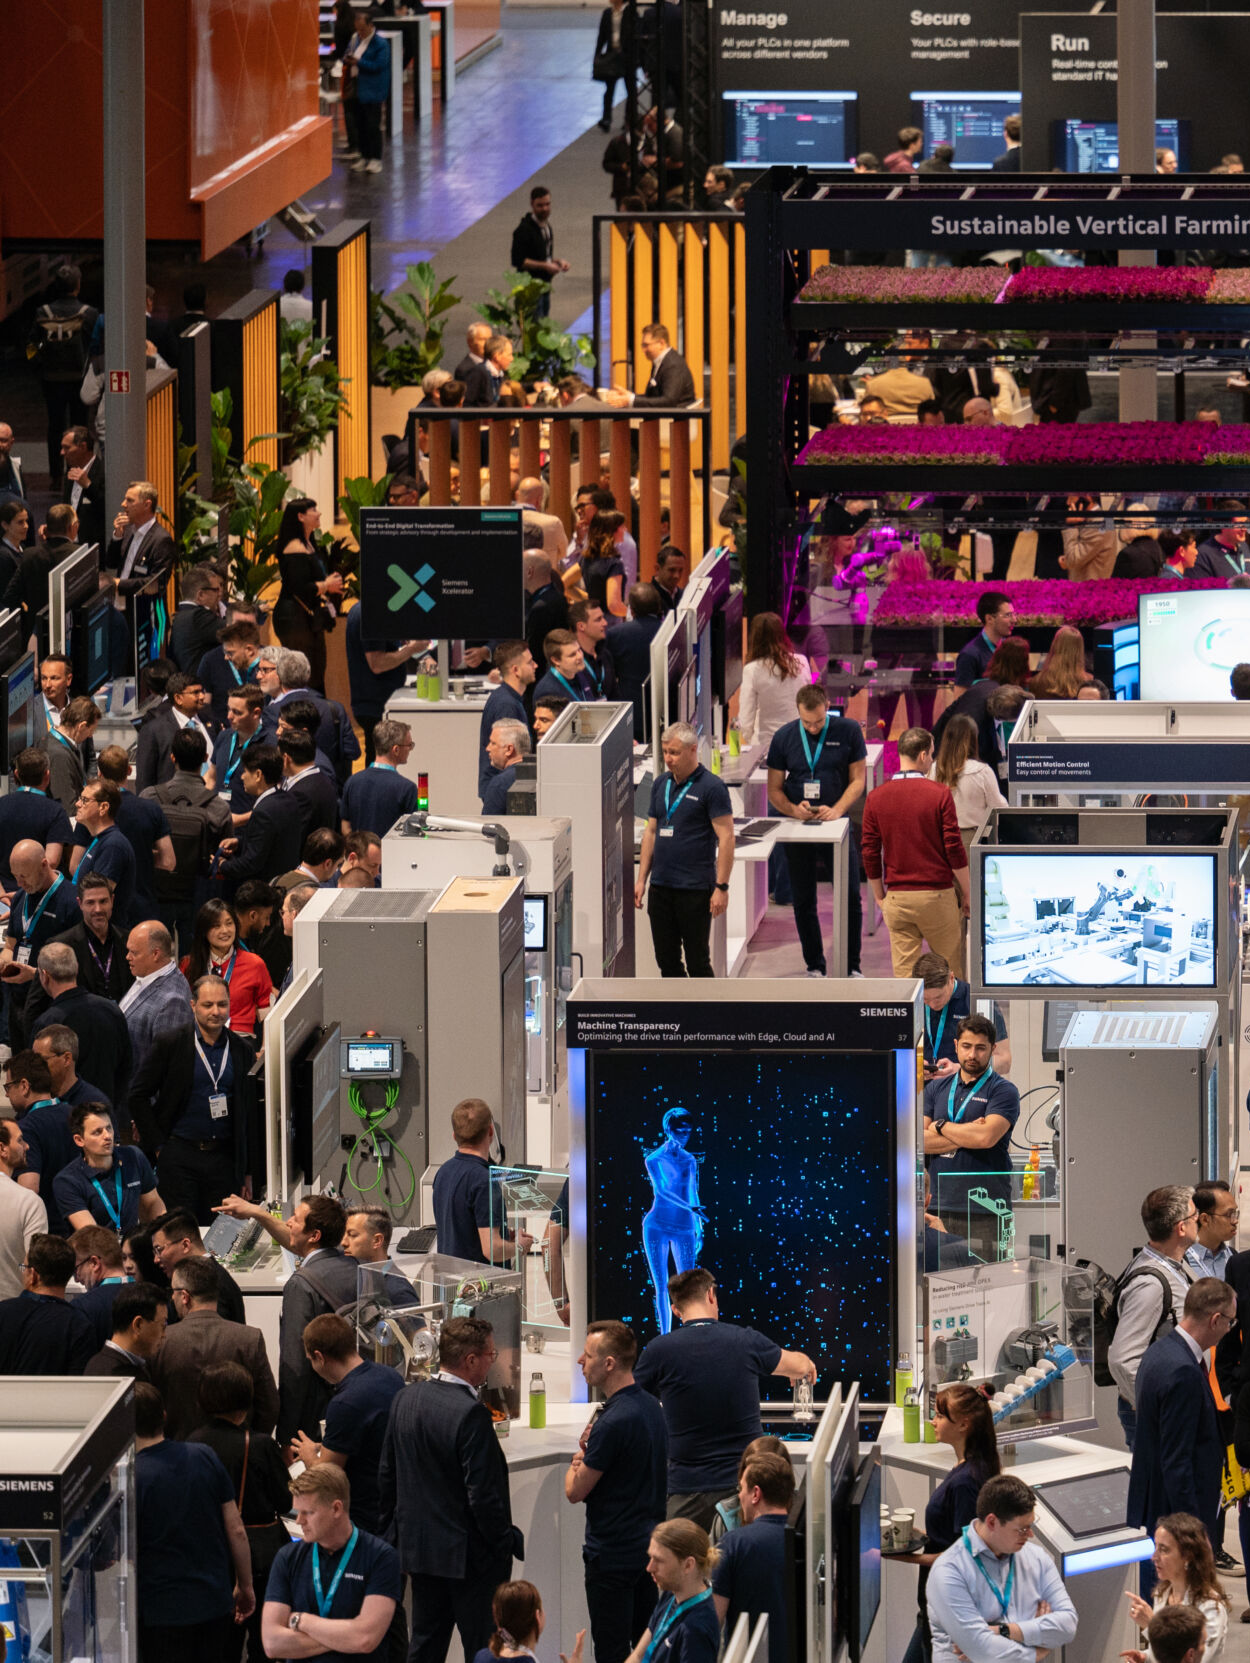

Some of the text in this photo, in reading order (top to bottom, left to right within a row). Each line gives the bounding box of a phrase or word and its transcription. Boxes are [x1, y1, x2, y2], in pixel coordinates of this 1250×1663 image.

[721, 10, 788, 29] Manage
[910, 10, 971, 25] Secure
[722, 38, 734, 47] All
[1051, 34, 1089, 51] Run
[930, 214, 1070, 235] Sustainable
[1076, 214, 1167, 235] Vertical
[442, 579, 468, 587] Siemens
[442, 587, 474, 595] Xcelerator
[860, 1008, 908, 1017] SIEMENS
[577, 1021, 680, 1032] Machine Transparency
[577, 1032, 835, 1042] Optimizing the drive train performance with Edge, Cloud and AI
[898, 1034, 908, 1042] 37
[0, 1481, 55, 1491] SIEMENS
[43, 1512, 54, 1520] 52
